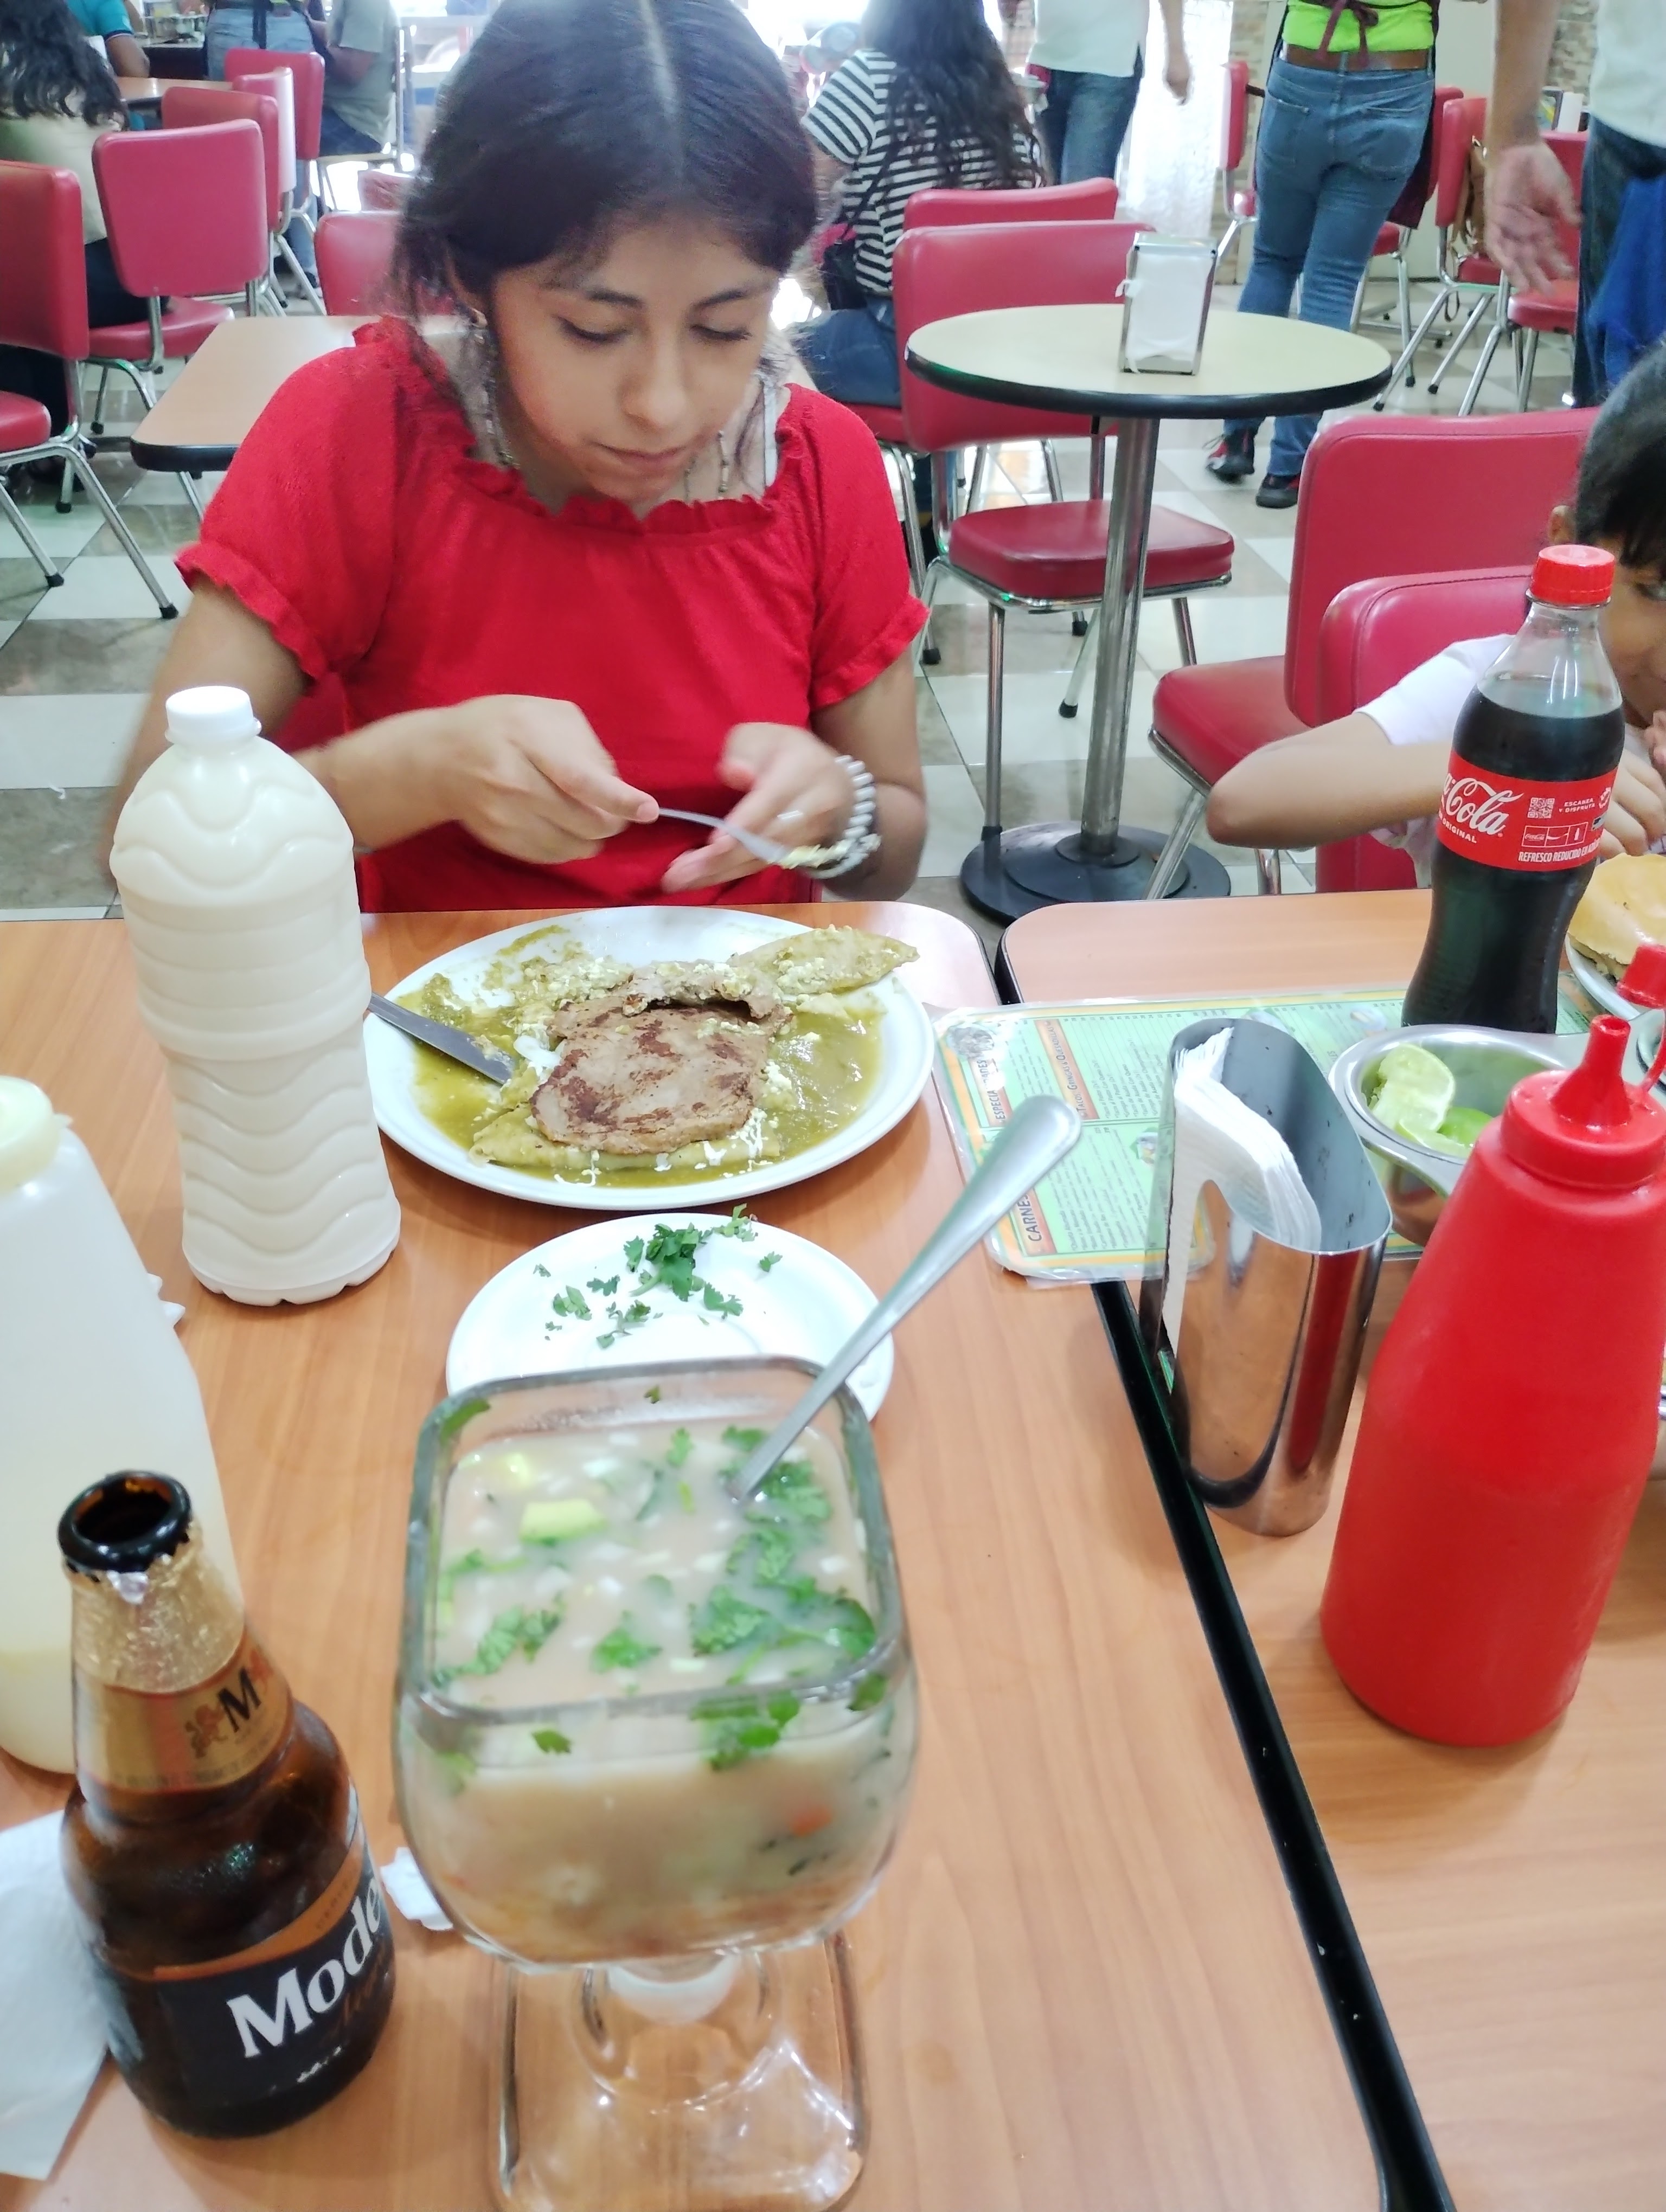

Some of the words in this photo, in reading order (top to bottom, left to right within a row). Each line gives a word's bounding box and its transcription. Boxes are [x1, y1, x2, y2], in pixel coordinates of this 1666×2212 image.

[1564, 798, 1594, 807] ESCANEA
[1565, 802, 1595, 813] DISFRUTA
[1442, 818, 1477, 844] ORIGINAL
[1518, 851, 1553, 863] REFRESCO
[1552, 847, 1582, 862] REDUCIDO
[1048, 1026, 1066, 1061] QUESADILLAS
[218, 1665, 262, 1733] M
[226, 1877, 381, 2059] Mode
